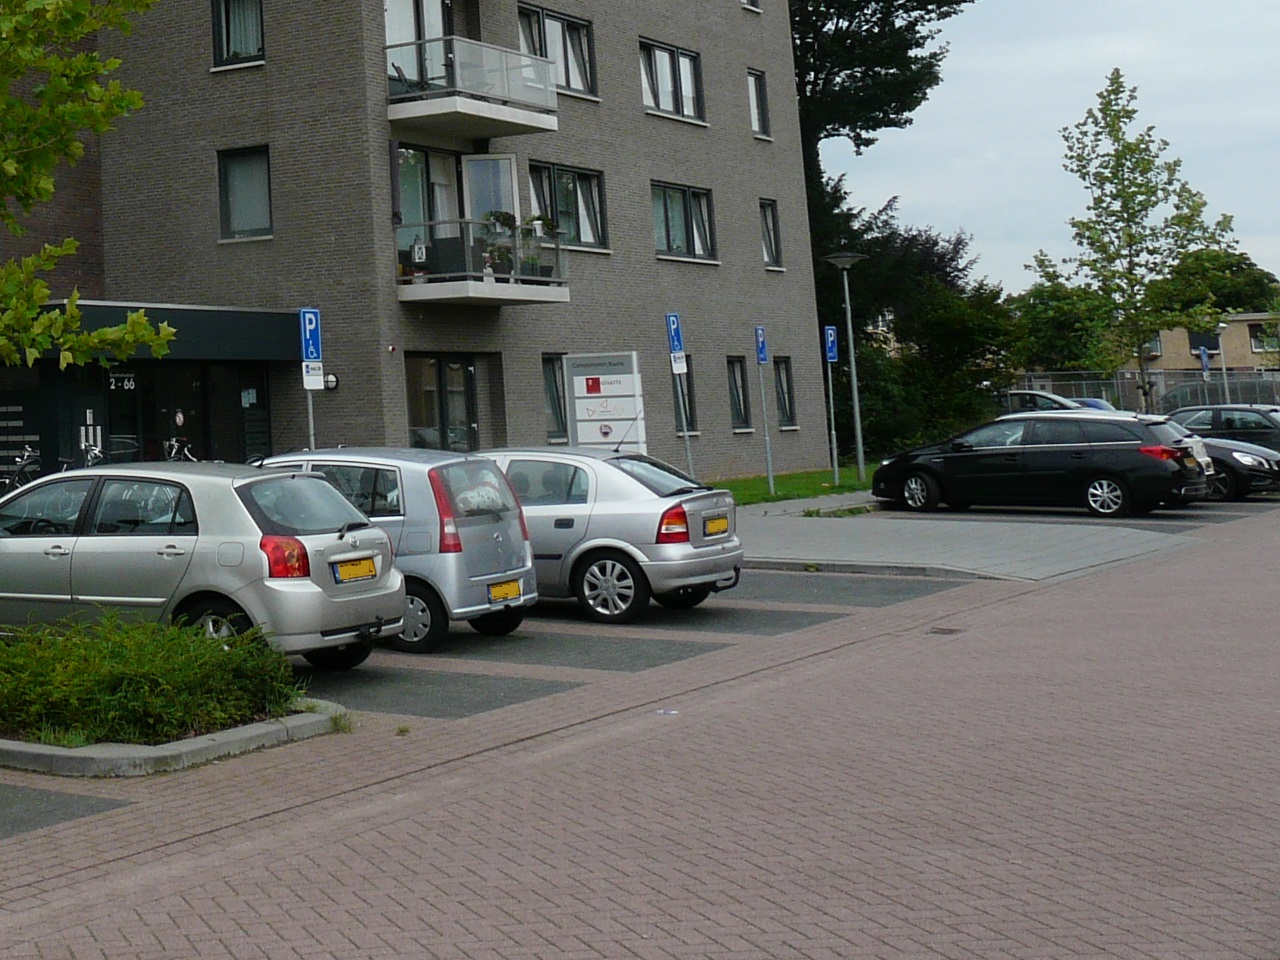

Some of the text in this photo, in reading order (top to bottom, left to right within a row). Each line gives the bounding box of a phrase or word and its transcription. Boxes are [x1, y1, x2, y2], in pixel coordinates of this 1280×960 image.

[305, 313, 316, 339] P
[670, 316, 678, 336] P
[827, 329, 835, 347] P
[110, 378, 116, 389] 2
[123, 378, 135, 390] 66
